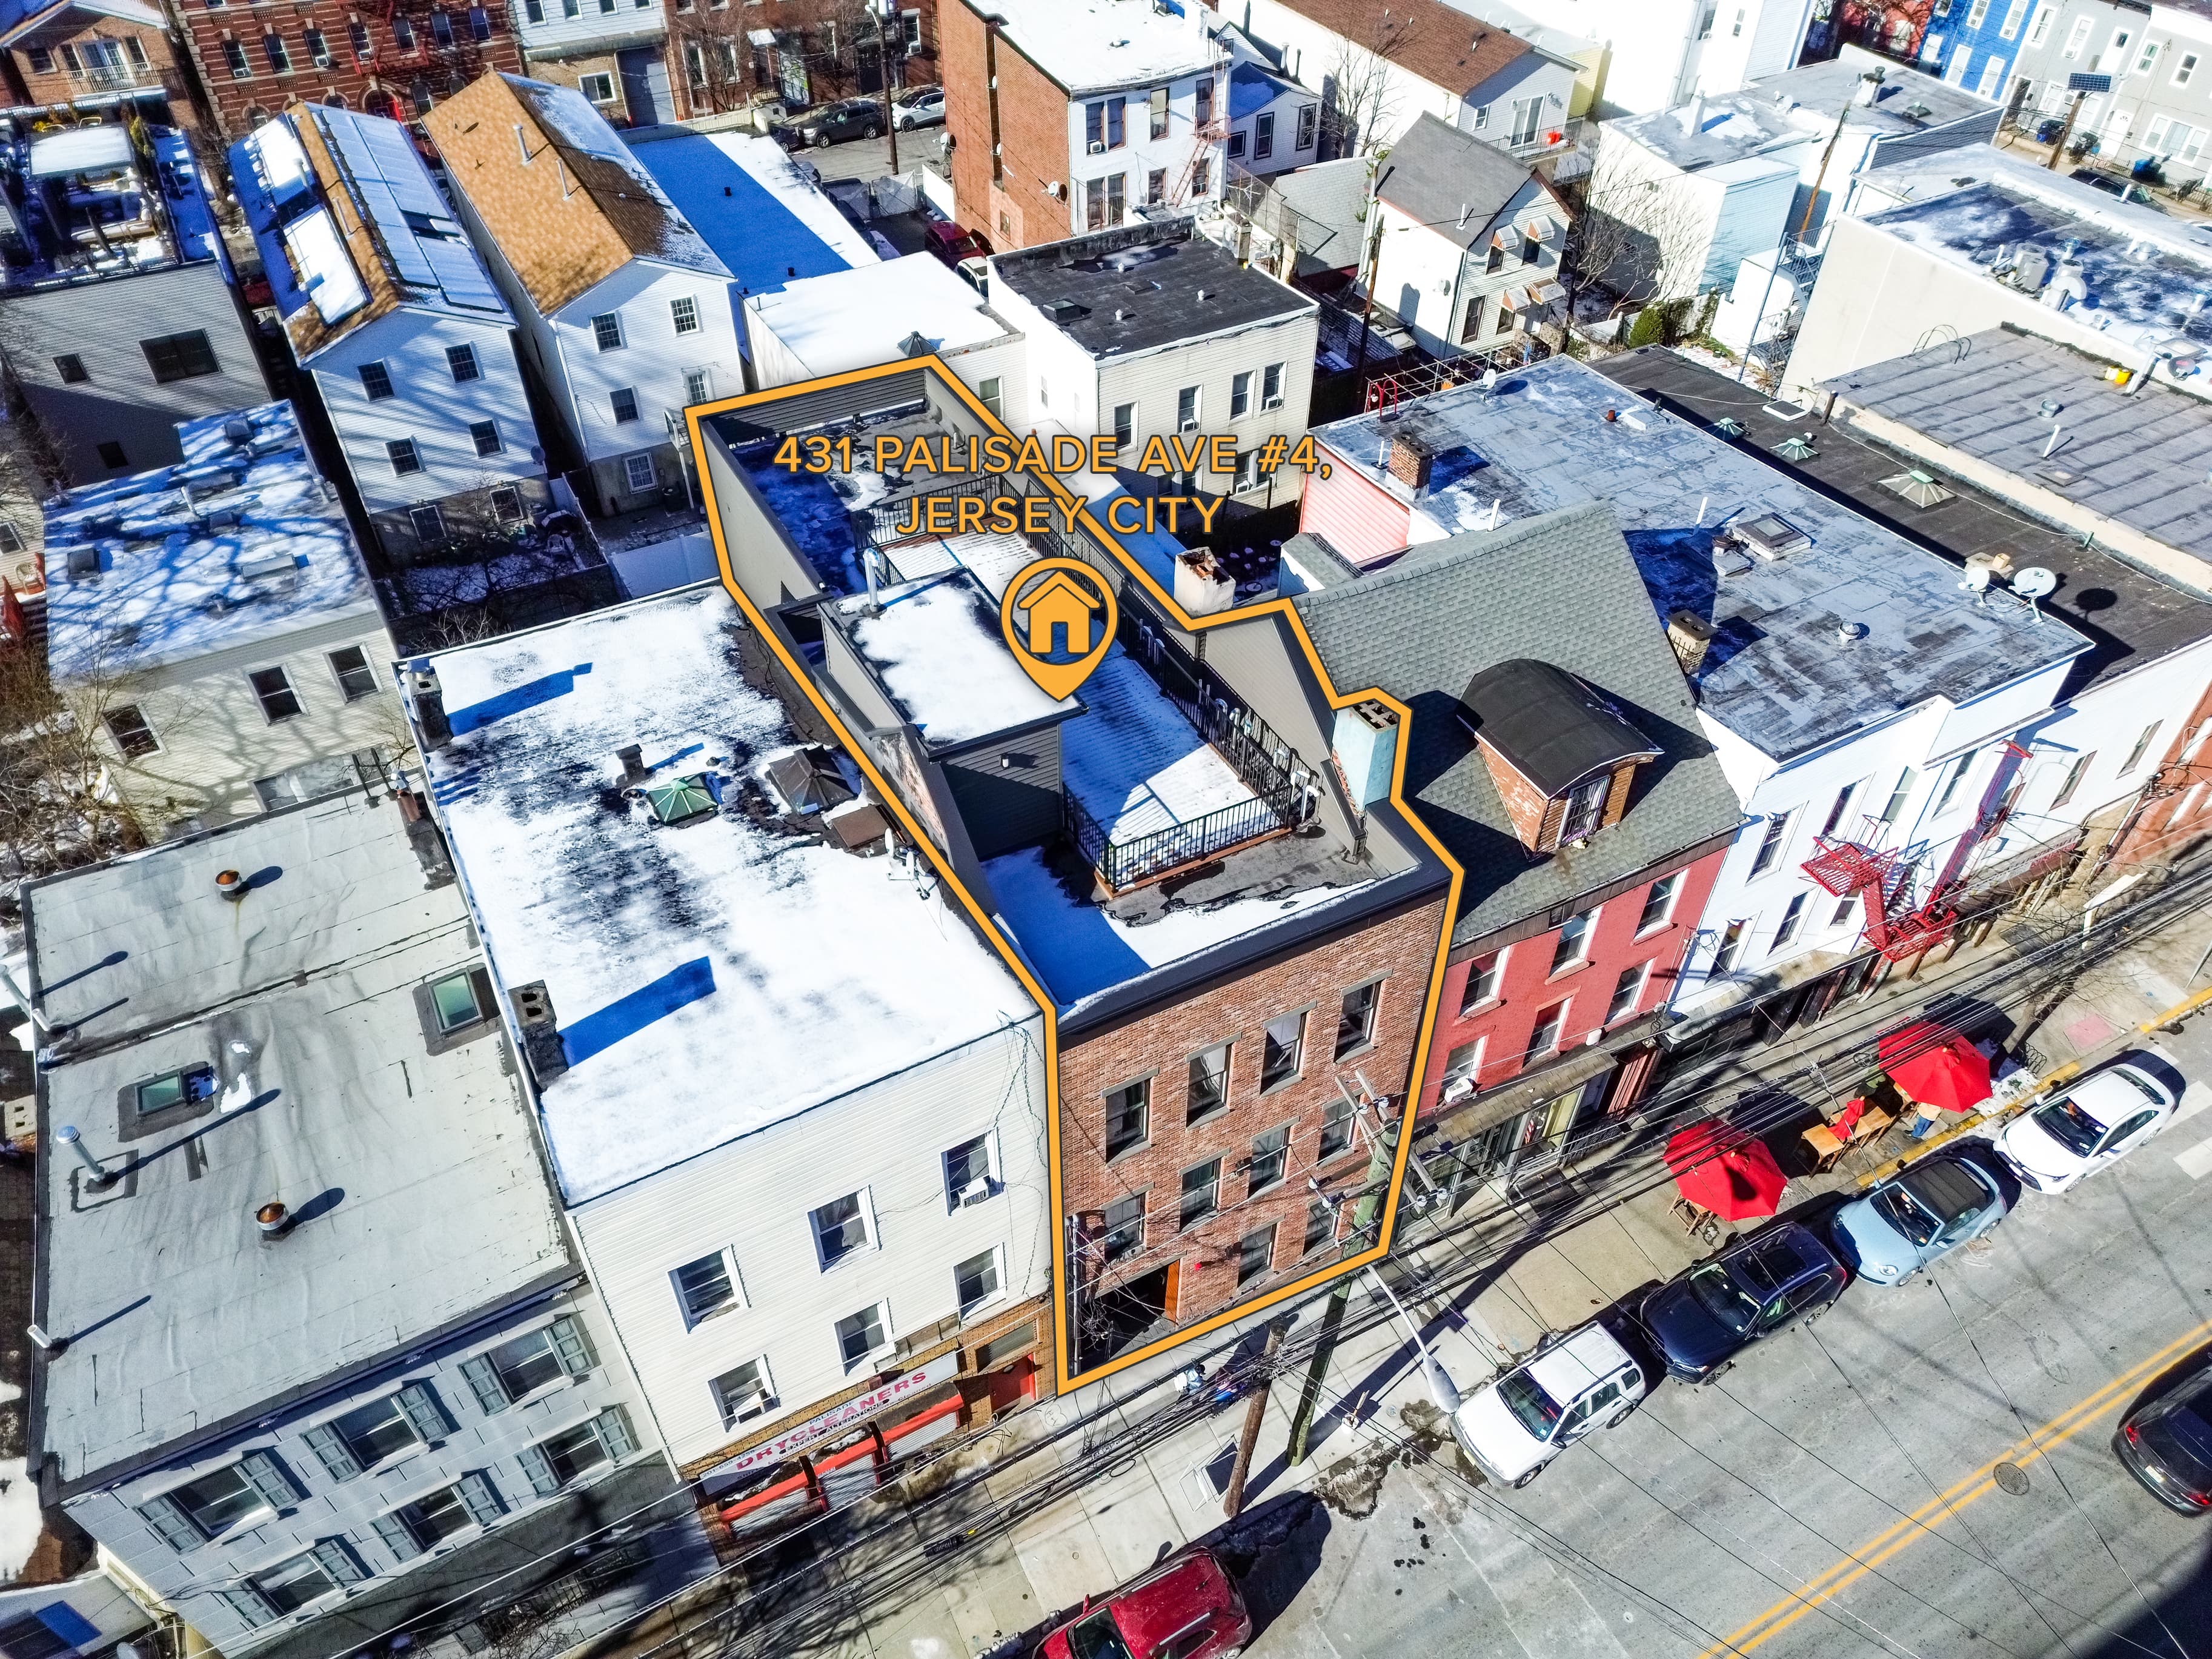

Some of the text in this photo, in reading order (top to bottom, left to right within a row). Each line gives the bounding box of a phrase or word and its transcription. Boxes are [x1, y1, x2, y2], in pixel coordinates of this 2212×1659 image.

[735, 1370, 926, 1471] DRYCLEANERS
[784, 1400, 883, 1452] EXPERT ALTERATIONS
